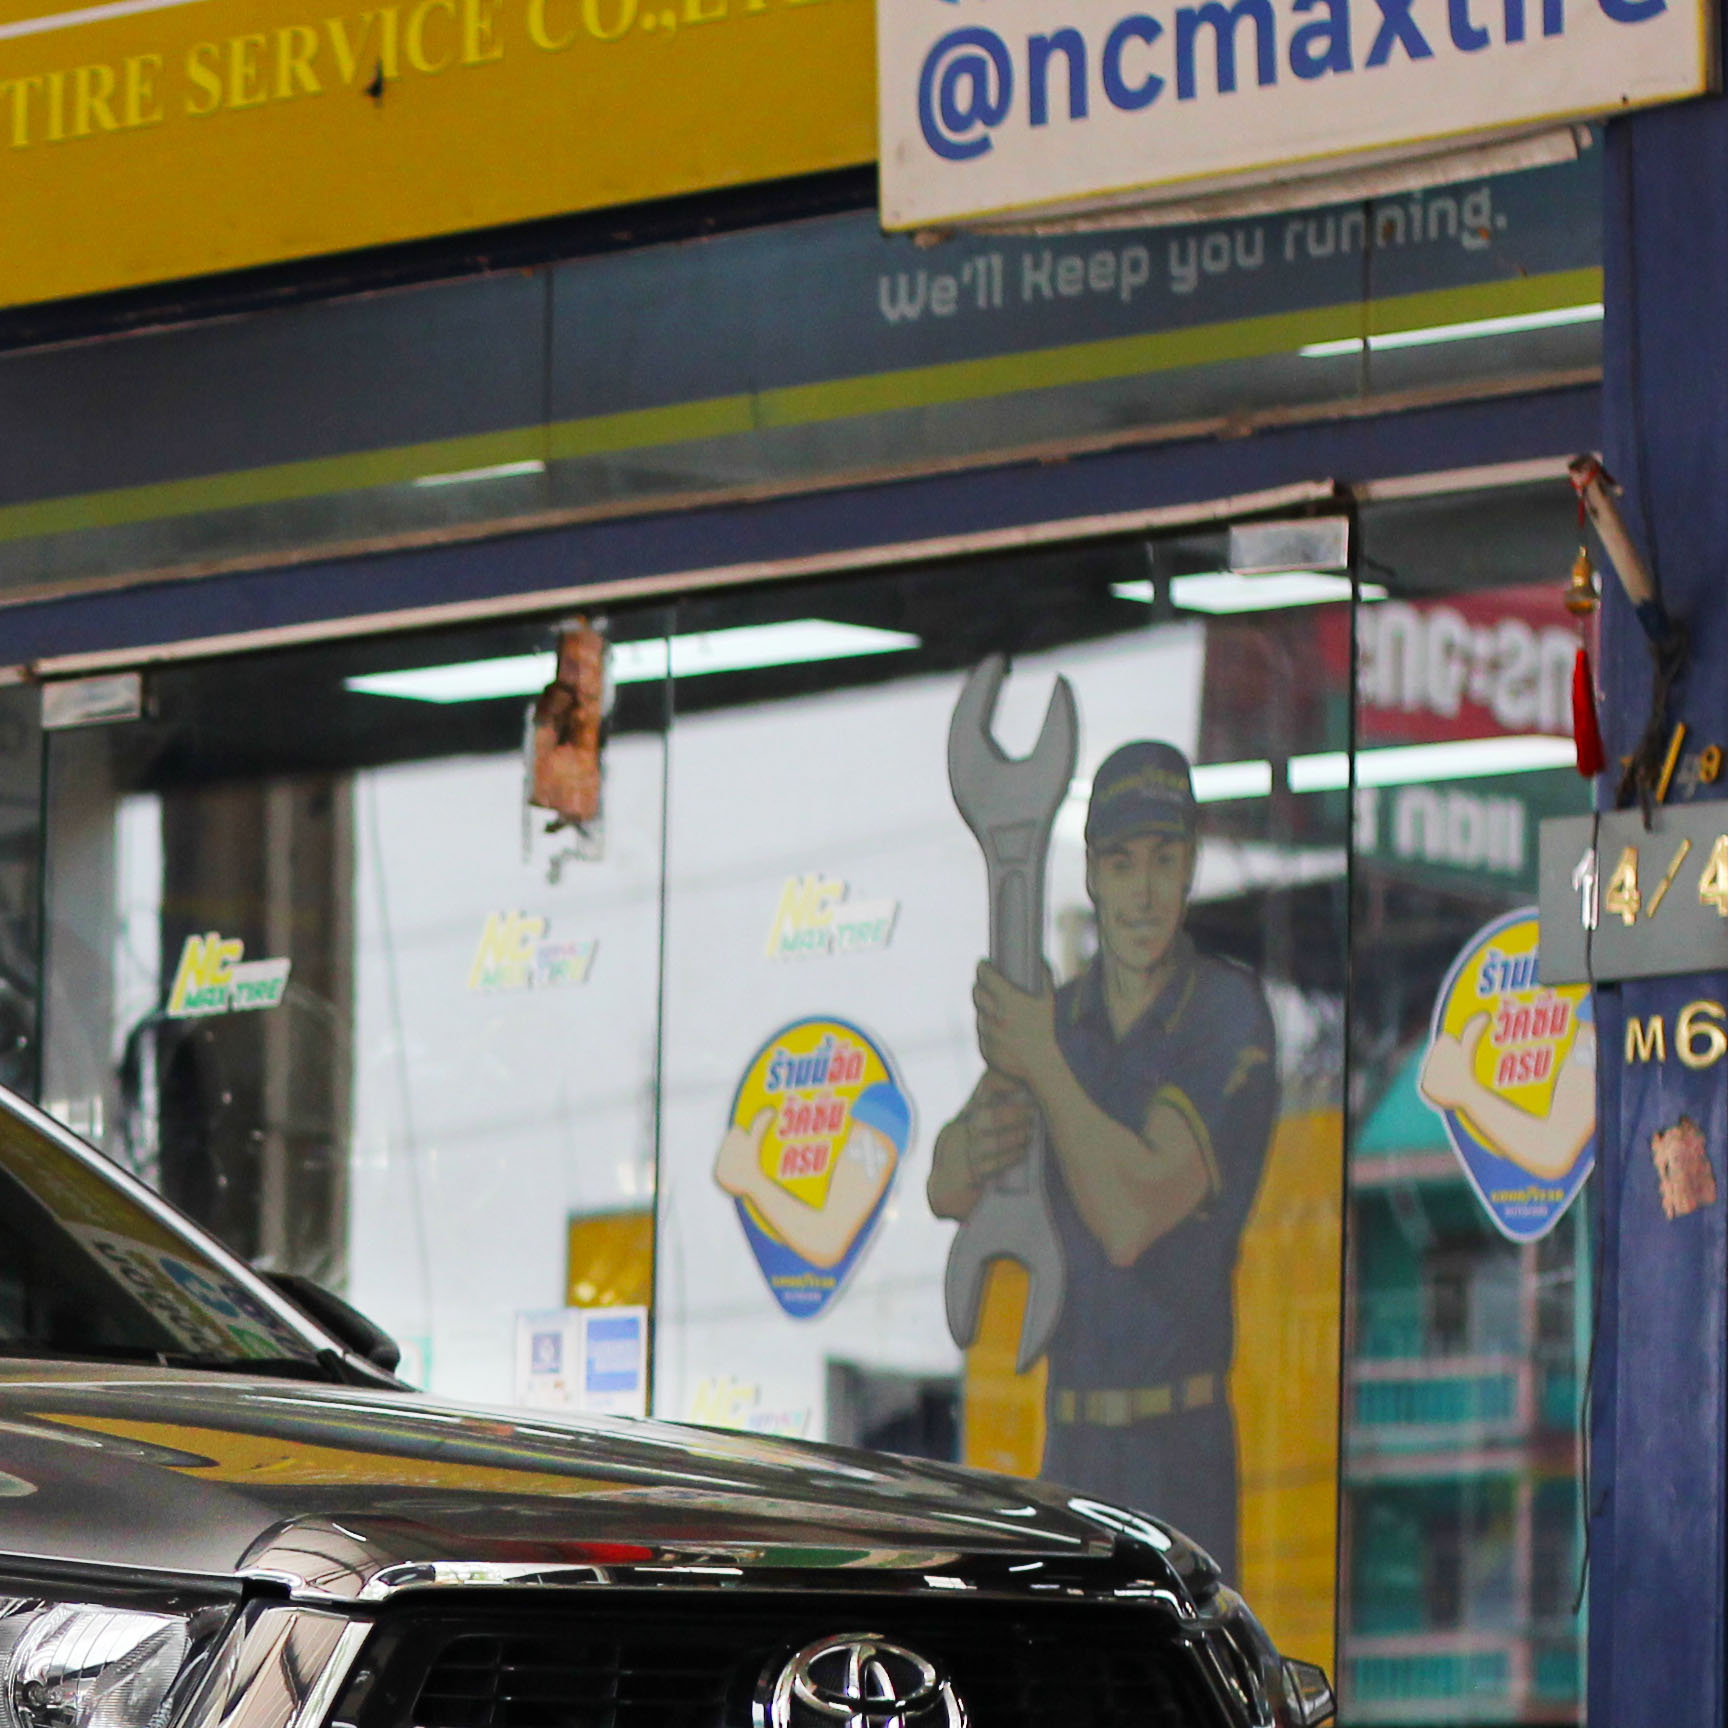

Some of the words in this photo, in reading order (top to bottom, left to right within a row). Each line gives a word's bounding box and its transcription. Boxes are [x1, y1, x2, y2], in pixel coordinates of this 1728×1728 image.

[184, 0, 505, 118] SERVICE
[877, 250, 1004, 324] We'll
[1021, 238, 1150, 307] Keep
[1169, 223, 1266, 295] you
[1283, 185, 1509, 263] running.
[169, 932, 243, 1016] NC
[1497, 1048, 1553, 1086] ครบ
[779, 1144, 830, 1180] ครบ
